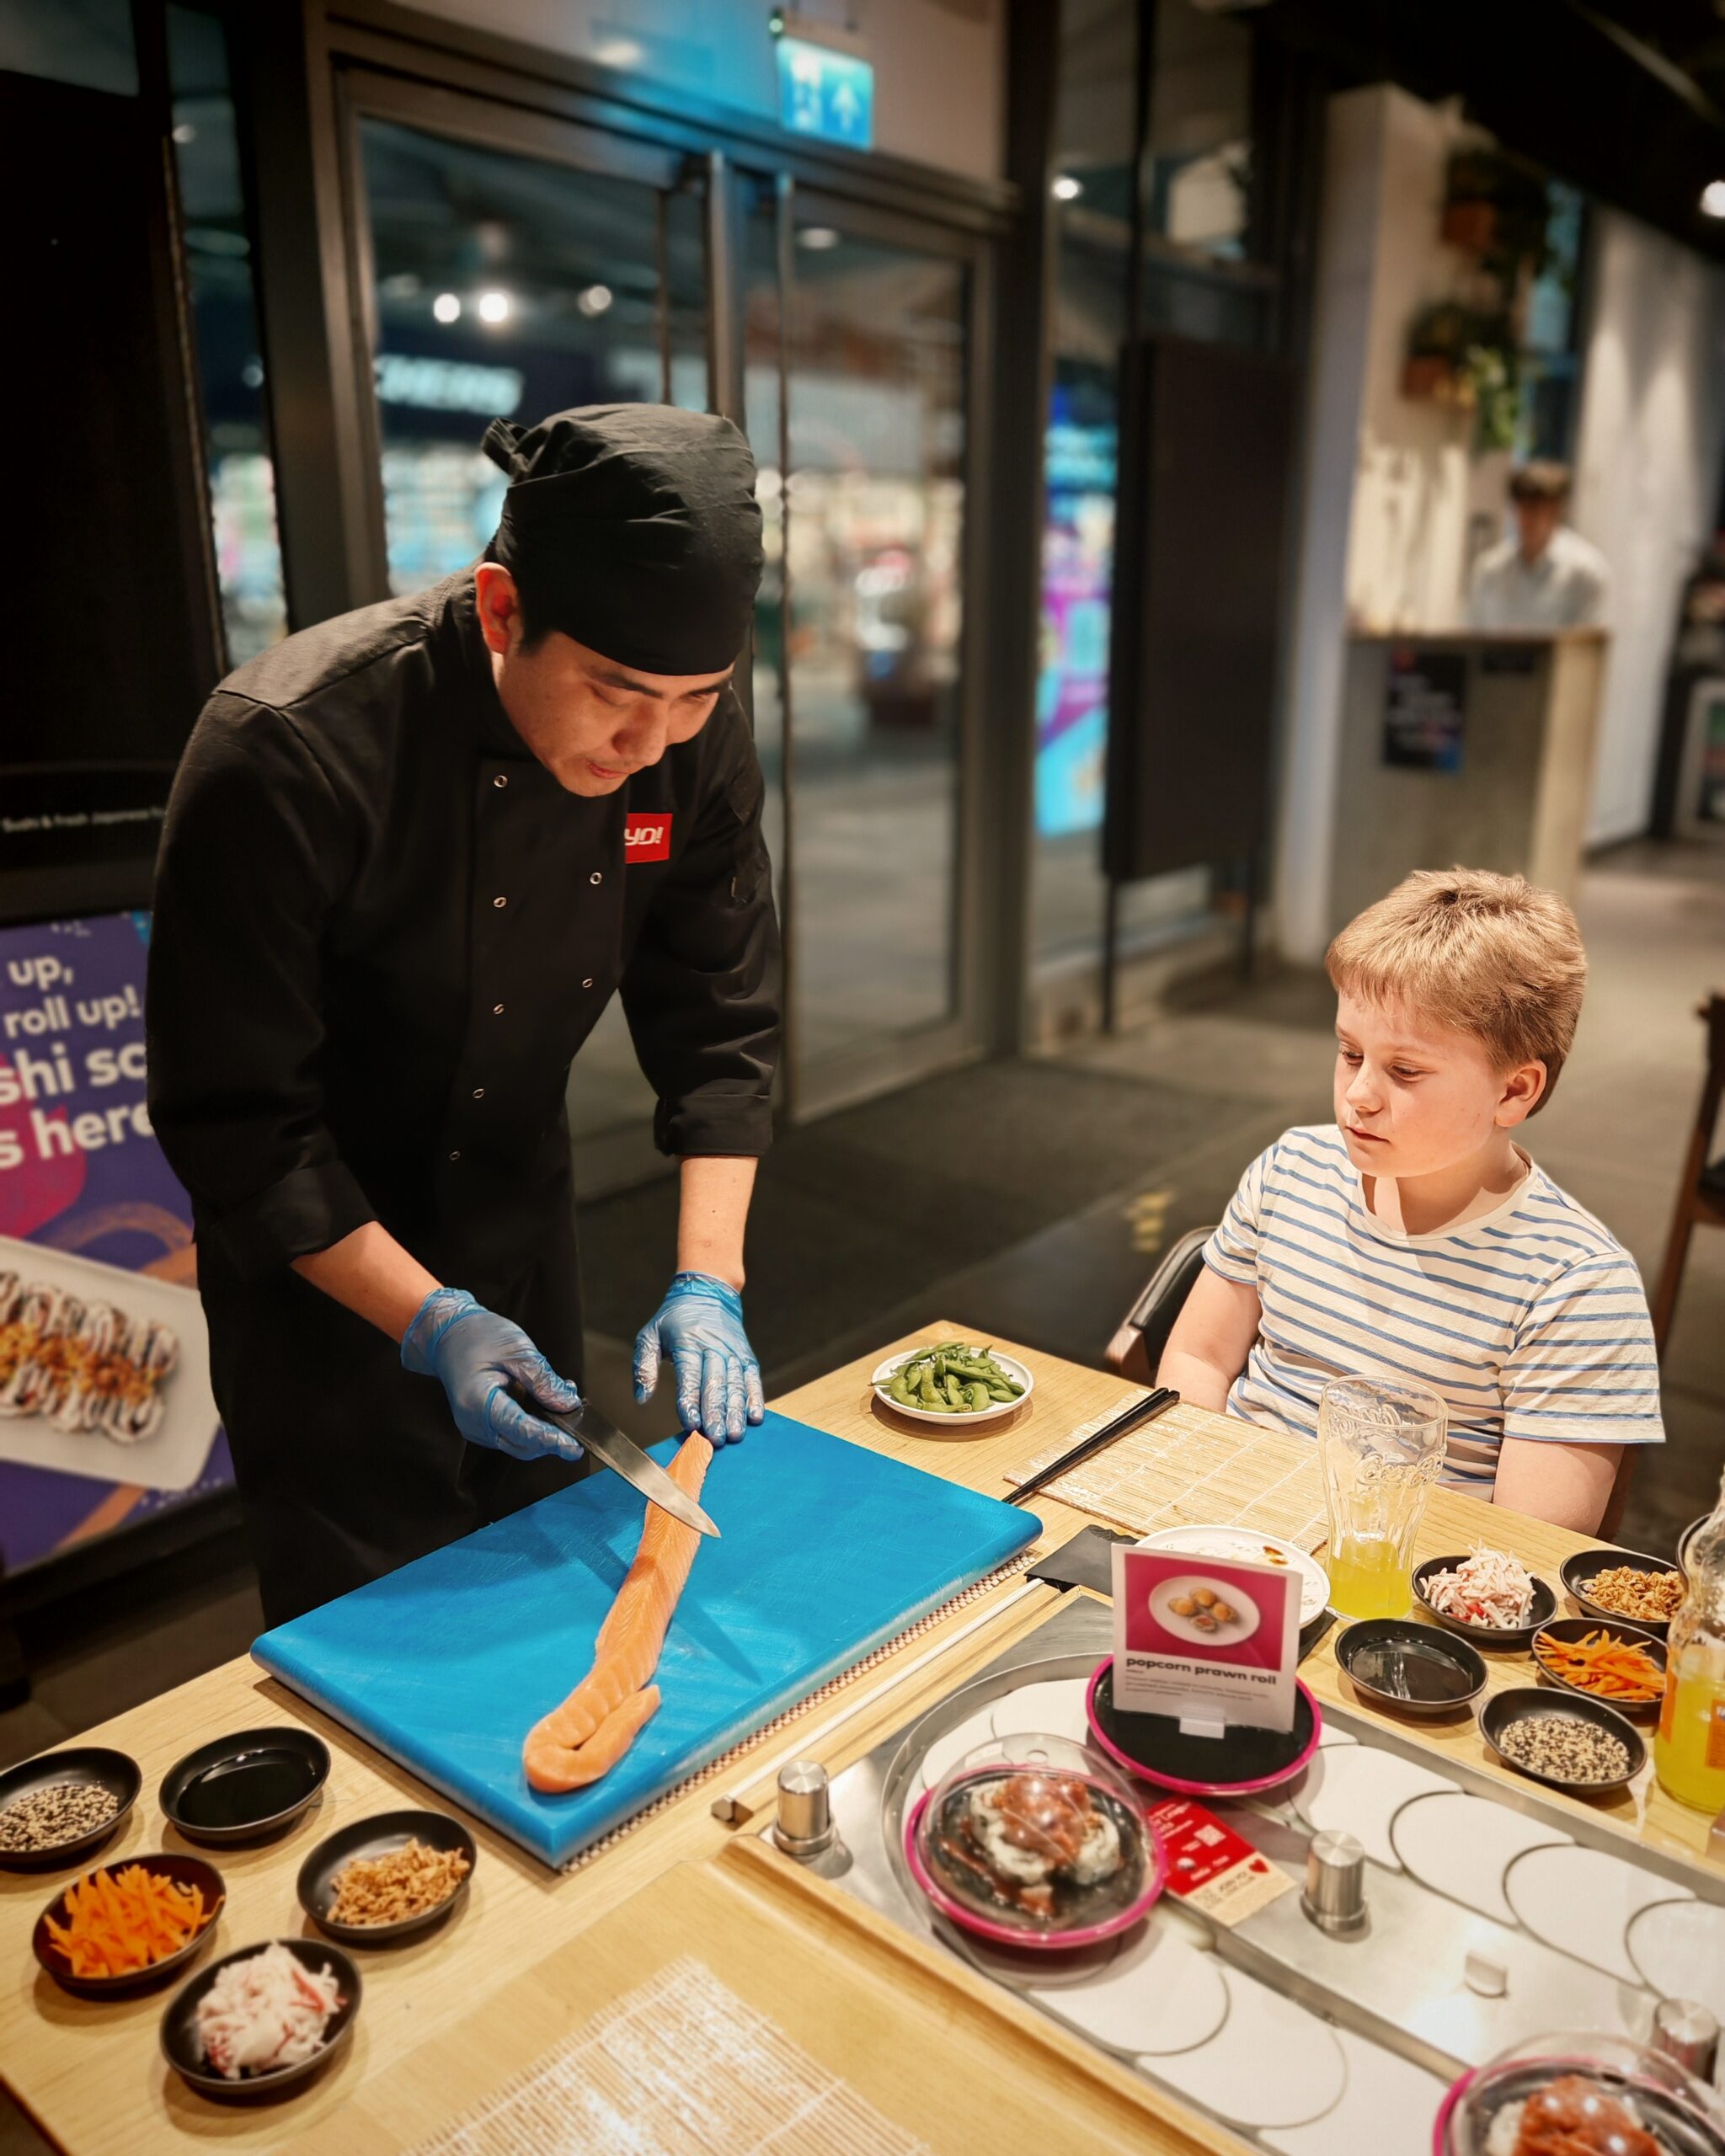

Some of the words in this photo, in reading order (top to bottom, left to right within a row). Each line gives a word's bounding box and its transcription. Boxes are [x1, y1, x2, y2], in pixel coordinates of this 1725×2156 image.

[7, 955, 74, 991] up,
[3, 995, 72, 1038] roll
[76, 984, 142, 1030] up!
[1126, 1657, 1191, 1673] popcorn
[1194, 1665, 1247, 1680] prawn
[1251, 1674, 1276, 1685] roll
